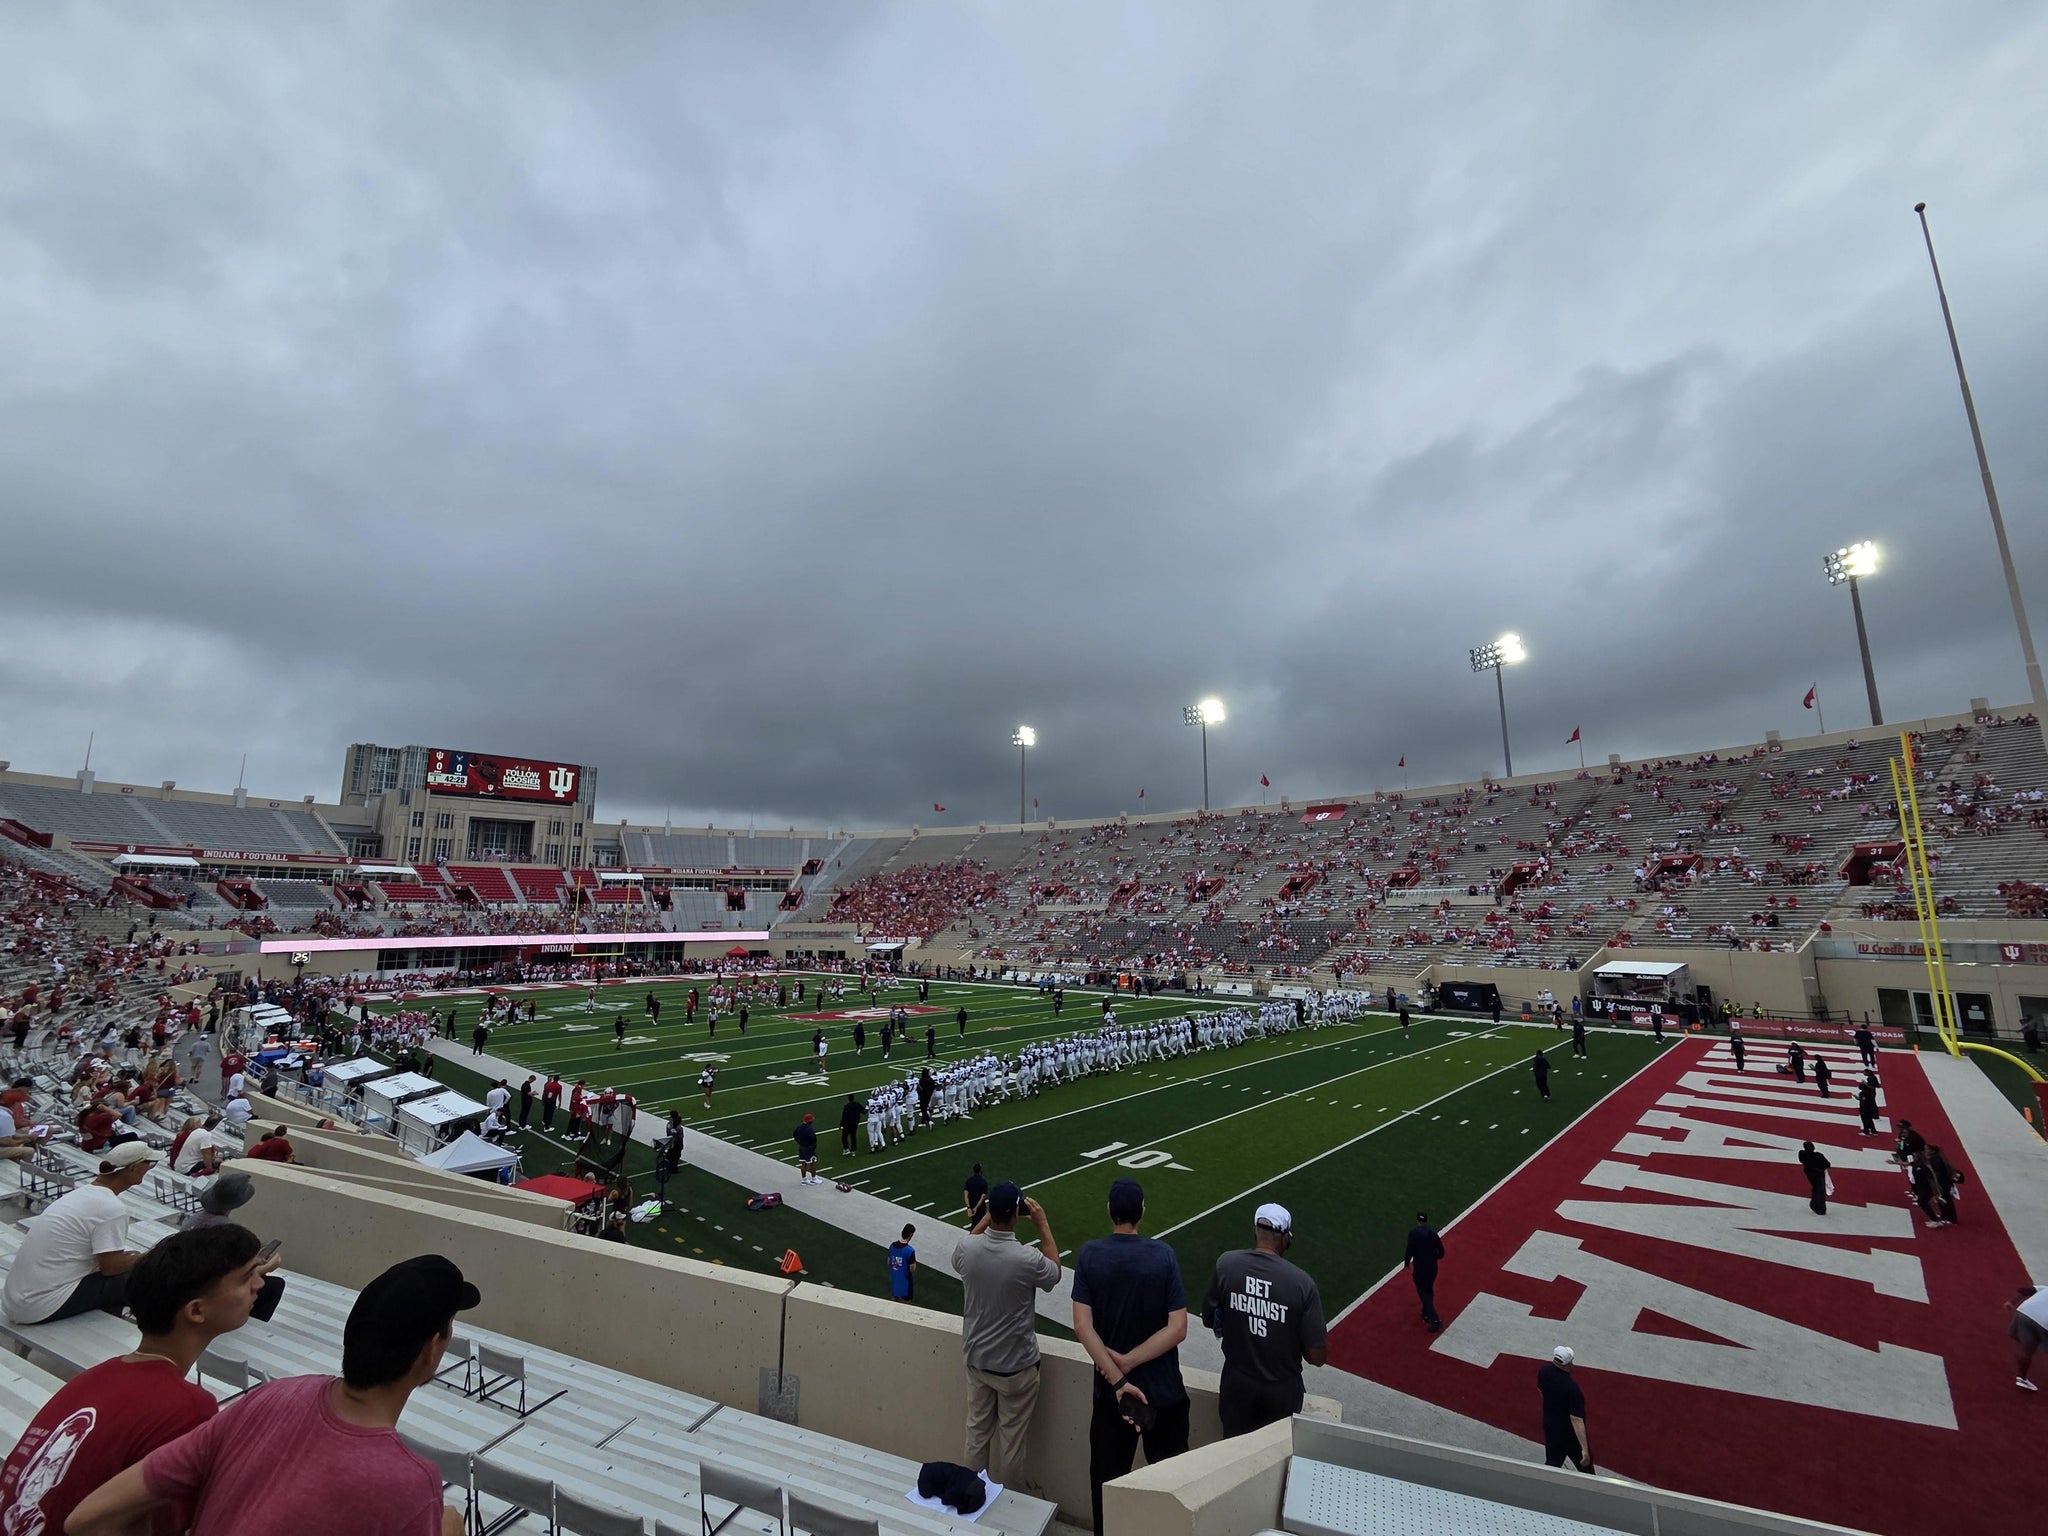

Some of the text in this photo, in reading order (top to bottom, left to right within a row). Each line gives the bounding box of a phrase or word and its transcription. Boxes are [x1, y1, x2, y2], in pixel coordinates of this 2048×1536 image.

[436, 762, 443, 770] 0
[456, 764, 463, 772] 0
[505, 769, 540, 779] FOLLOW
[444, 776, 466, 784] 42:28
[503, 775, 541, 785] HOOSIER
[202, 850, 289, 862] INDIANA FOOTBALL
[1870, 847, 1883, 855] 31
[541, 944, 574, 953] INDIANA
[1858, 943, 1938, 956] IU Credit Uno
[294, 953, 308, 962] 25
[1793, 1026, 1839, 1035] Google Gemini
[869, 1104, 883, 1114] 23
[1079, 1141, 1174, 1169] 10
[1245, 1275, 1273, 1299] BET
[1230, 1292, 1288, 1323] AGAINST
[1248, 1315, 1267, 1337] US
